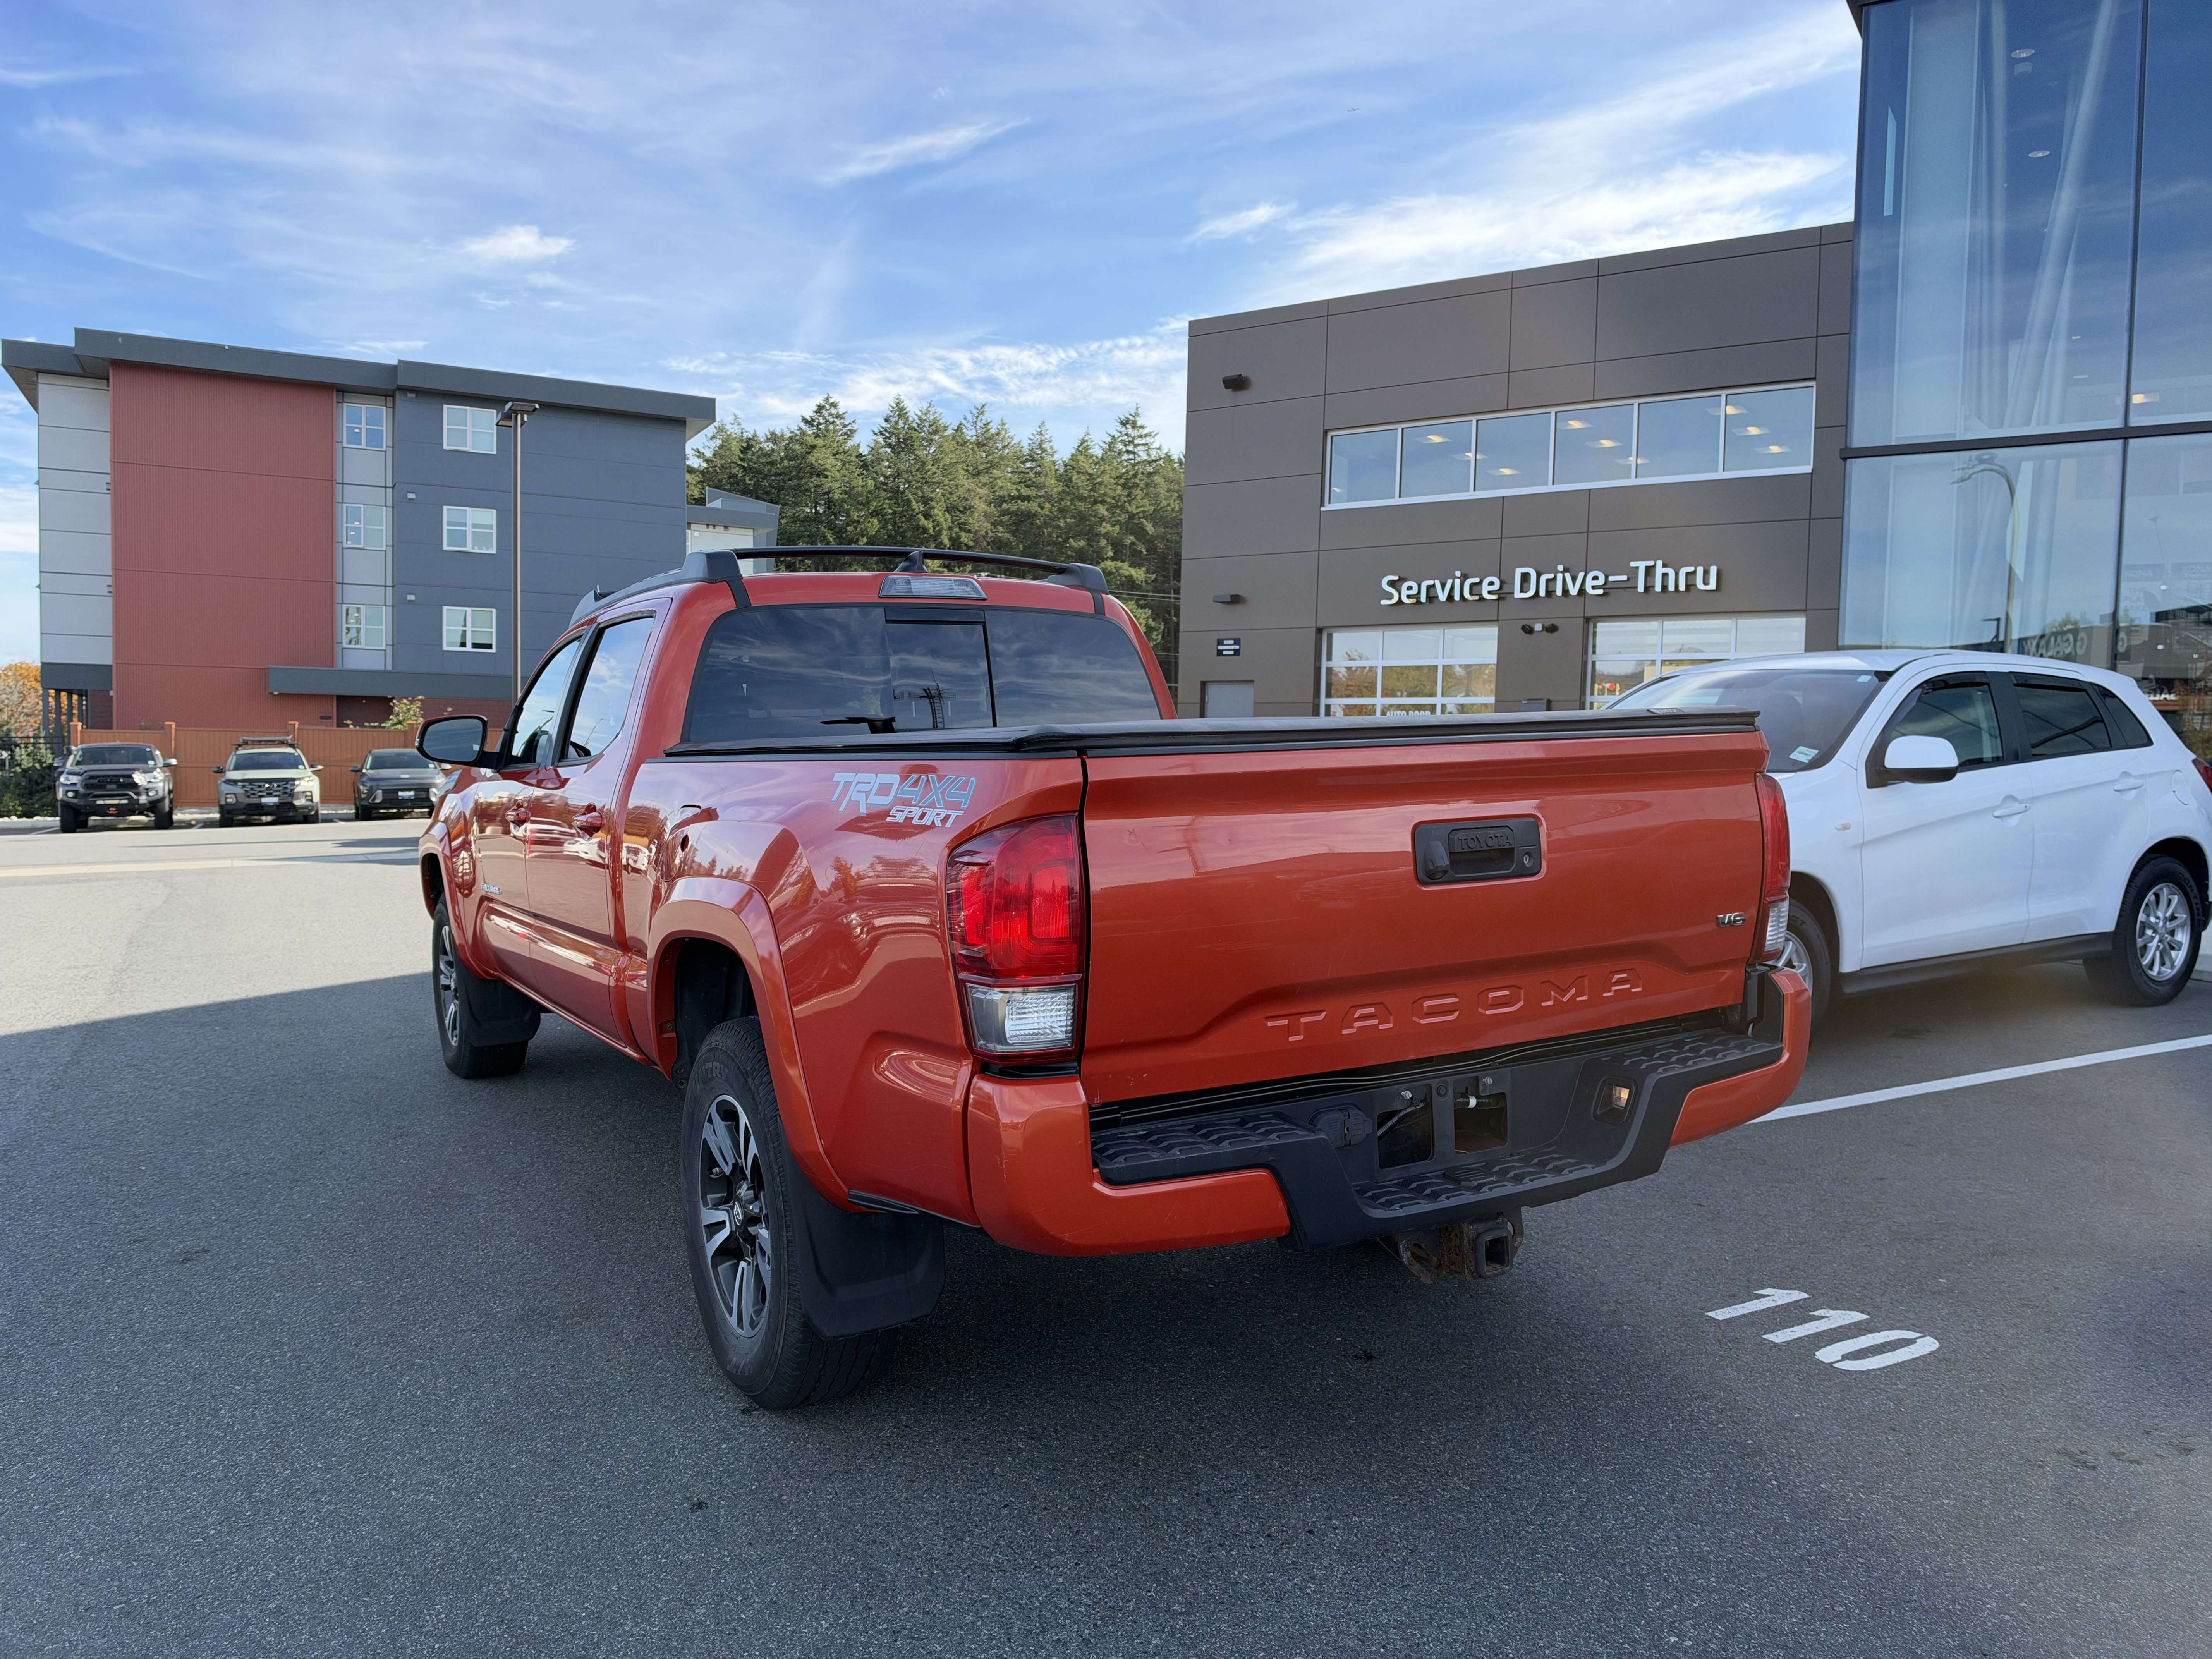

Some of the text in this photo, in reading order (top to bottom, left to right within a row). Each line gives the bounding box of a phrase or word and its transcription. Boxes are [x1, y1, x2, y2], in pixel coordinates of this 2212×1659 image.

[1380, 560, 1717, 605] Service Drive-Thru
[831, 773, 900, 816] TRD
[885, 805, 964, 828] SPORT
[1457, 833, 1512, 850] TOYOTA
[1716, 912, 1747, 927] V6
[1264, 968, 1642, 1041] TACOMA
[1705, 1288, 1939, 1371] 110
